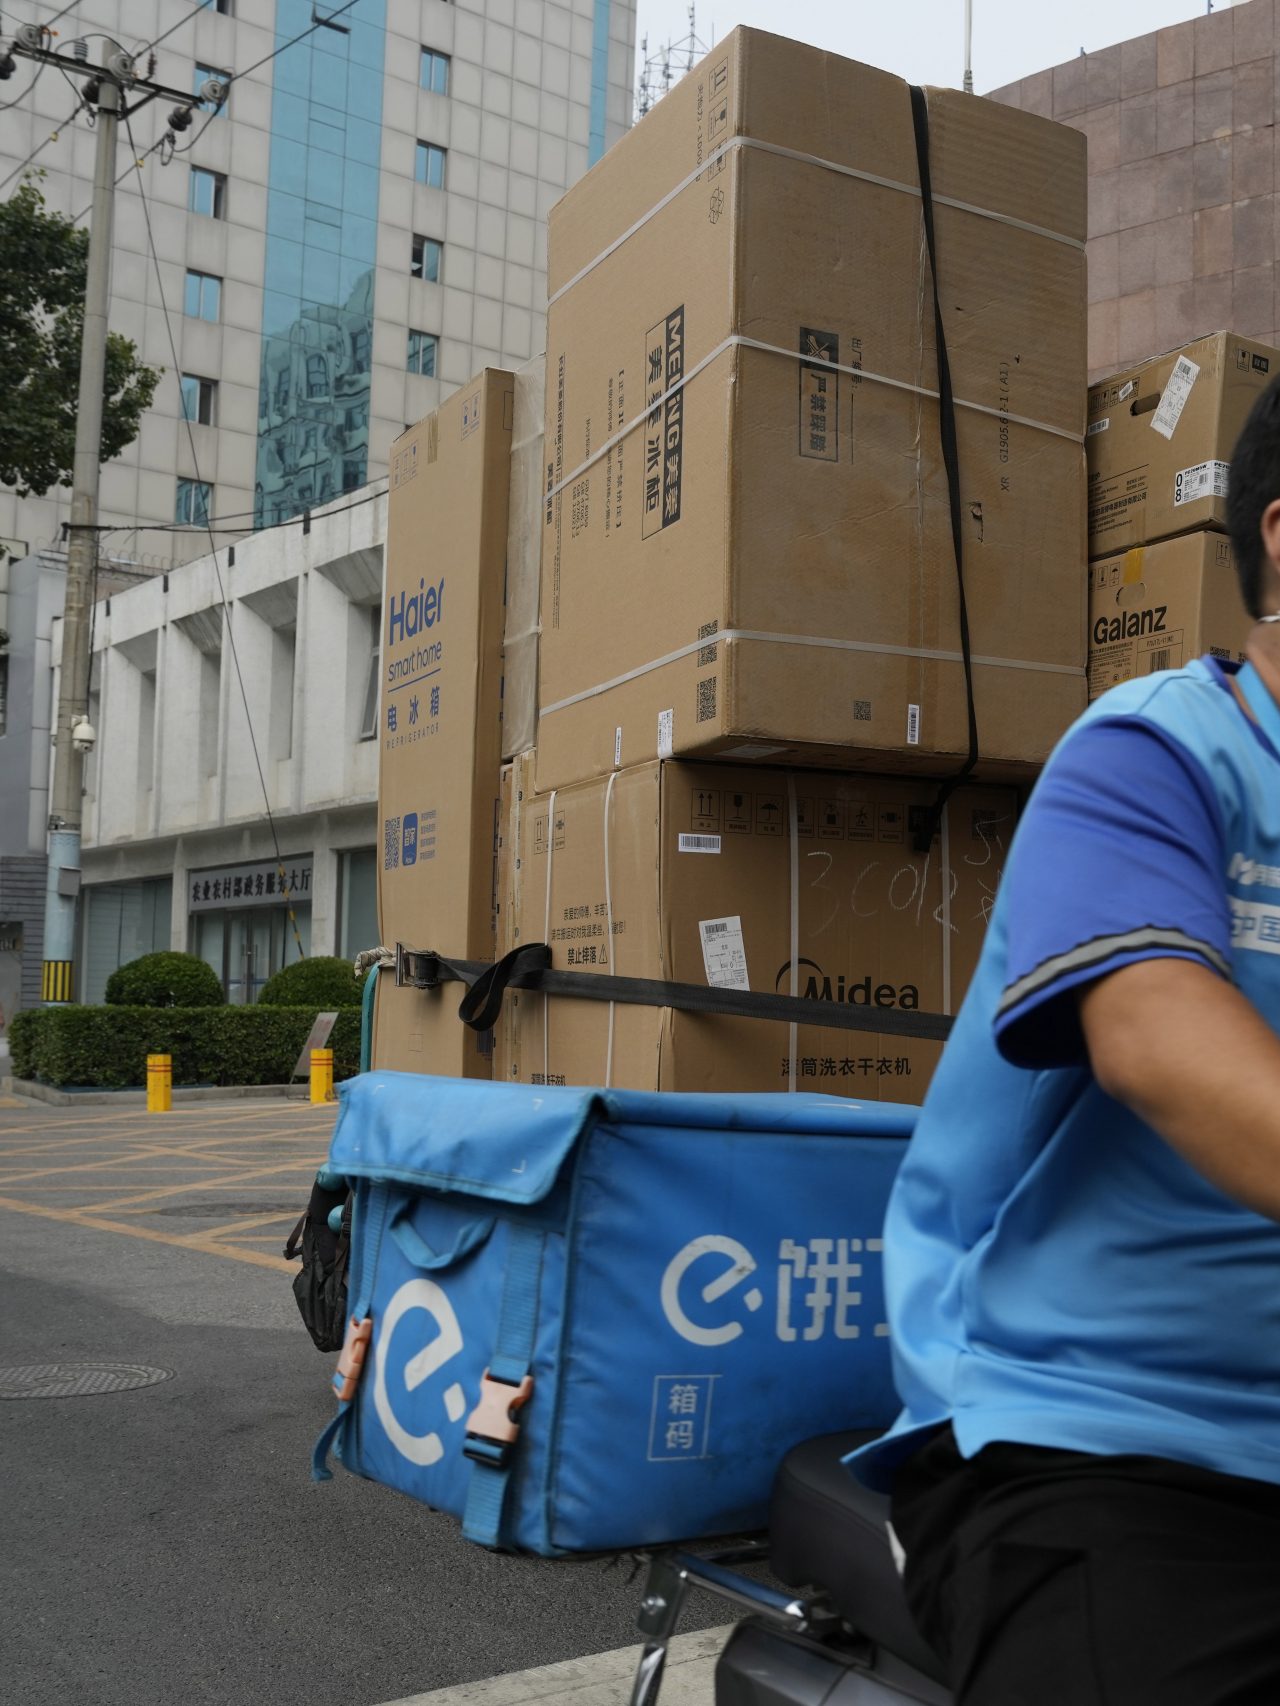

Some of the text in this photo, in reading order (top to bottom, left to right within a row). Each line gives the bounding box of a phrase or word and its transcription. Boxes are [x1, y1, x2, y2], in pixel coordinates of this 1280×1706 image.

[645, 344, 663, 515] 美菱冰柜
[810, 373, 827, 452] 严禁踩踏
[665, 453, 679, 519] 美菱
[389, 577, 444, 646] Haier
[1094, 606, 1167, 645] Galanz
[388, 640, 442, 682] smart home
[387, 685, 440, 732] 电冰箱
[386, 722, 439, 750] REFRIGERATOR
[192, 868, 311, 902] 农业农村部政务服务大厅
[567, 946, 597, 965] 禁止摔落
[803, 975, 919, 1009] Midea
[781, 1057, 912, 1077] 滚筒洗衣干衣机
[665, 1383, 699, 1450] 箱码
